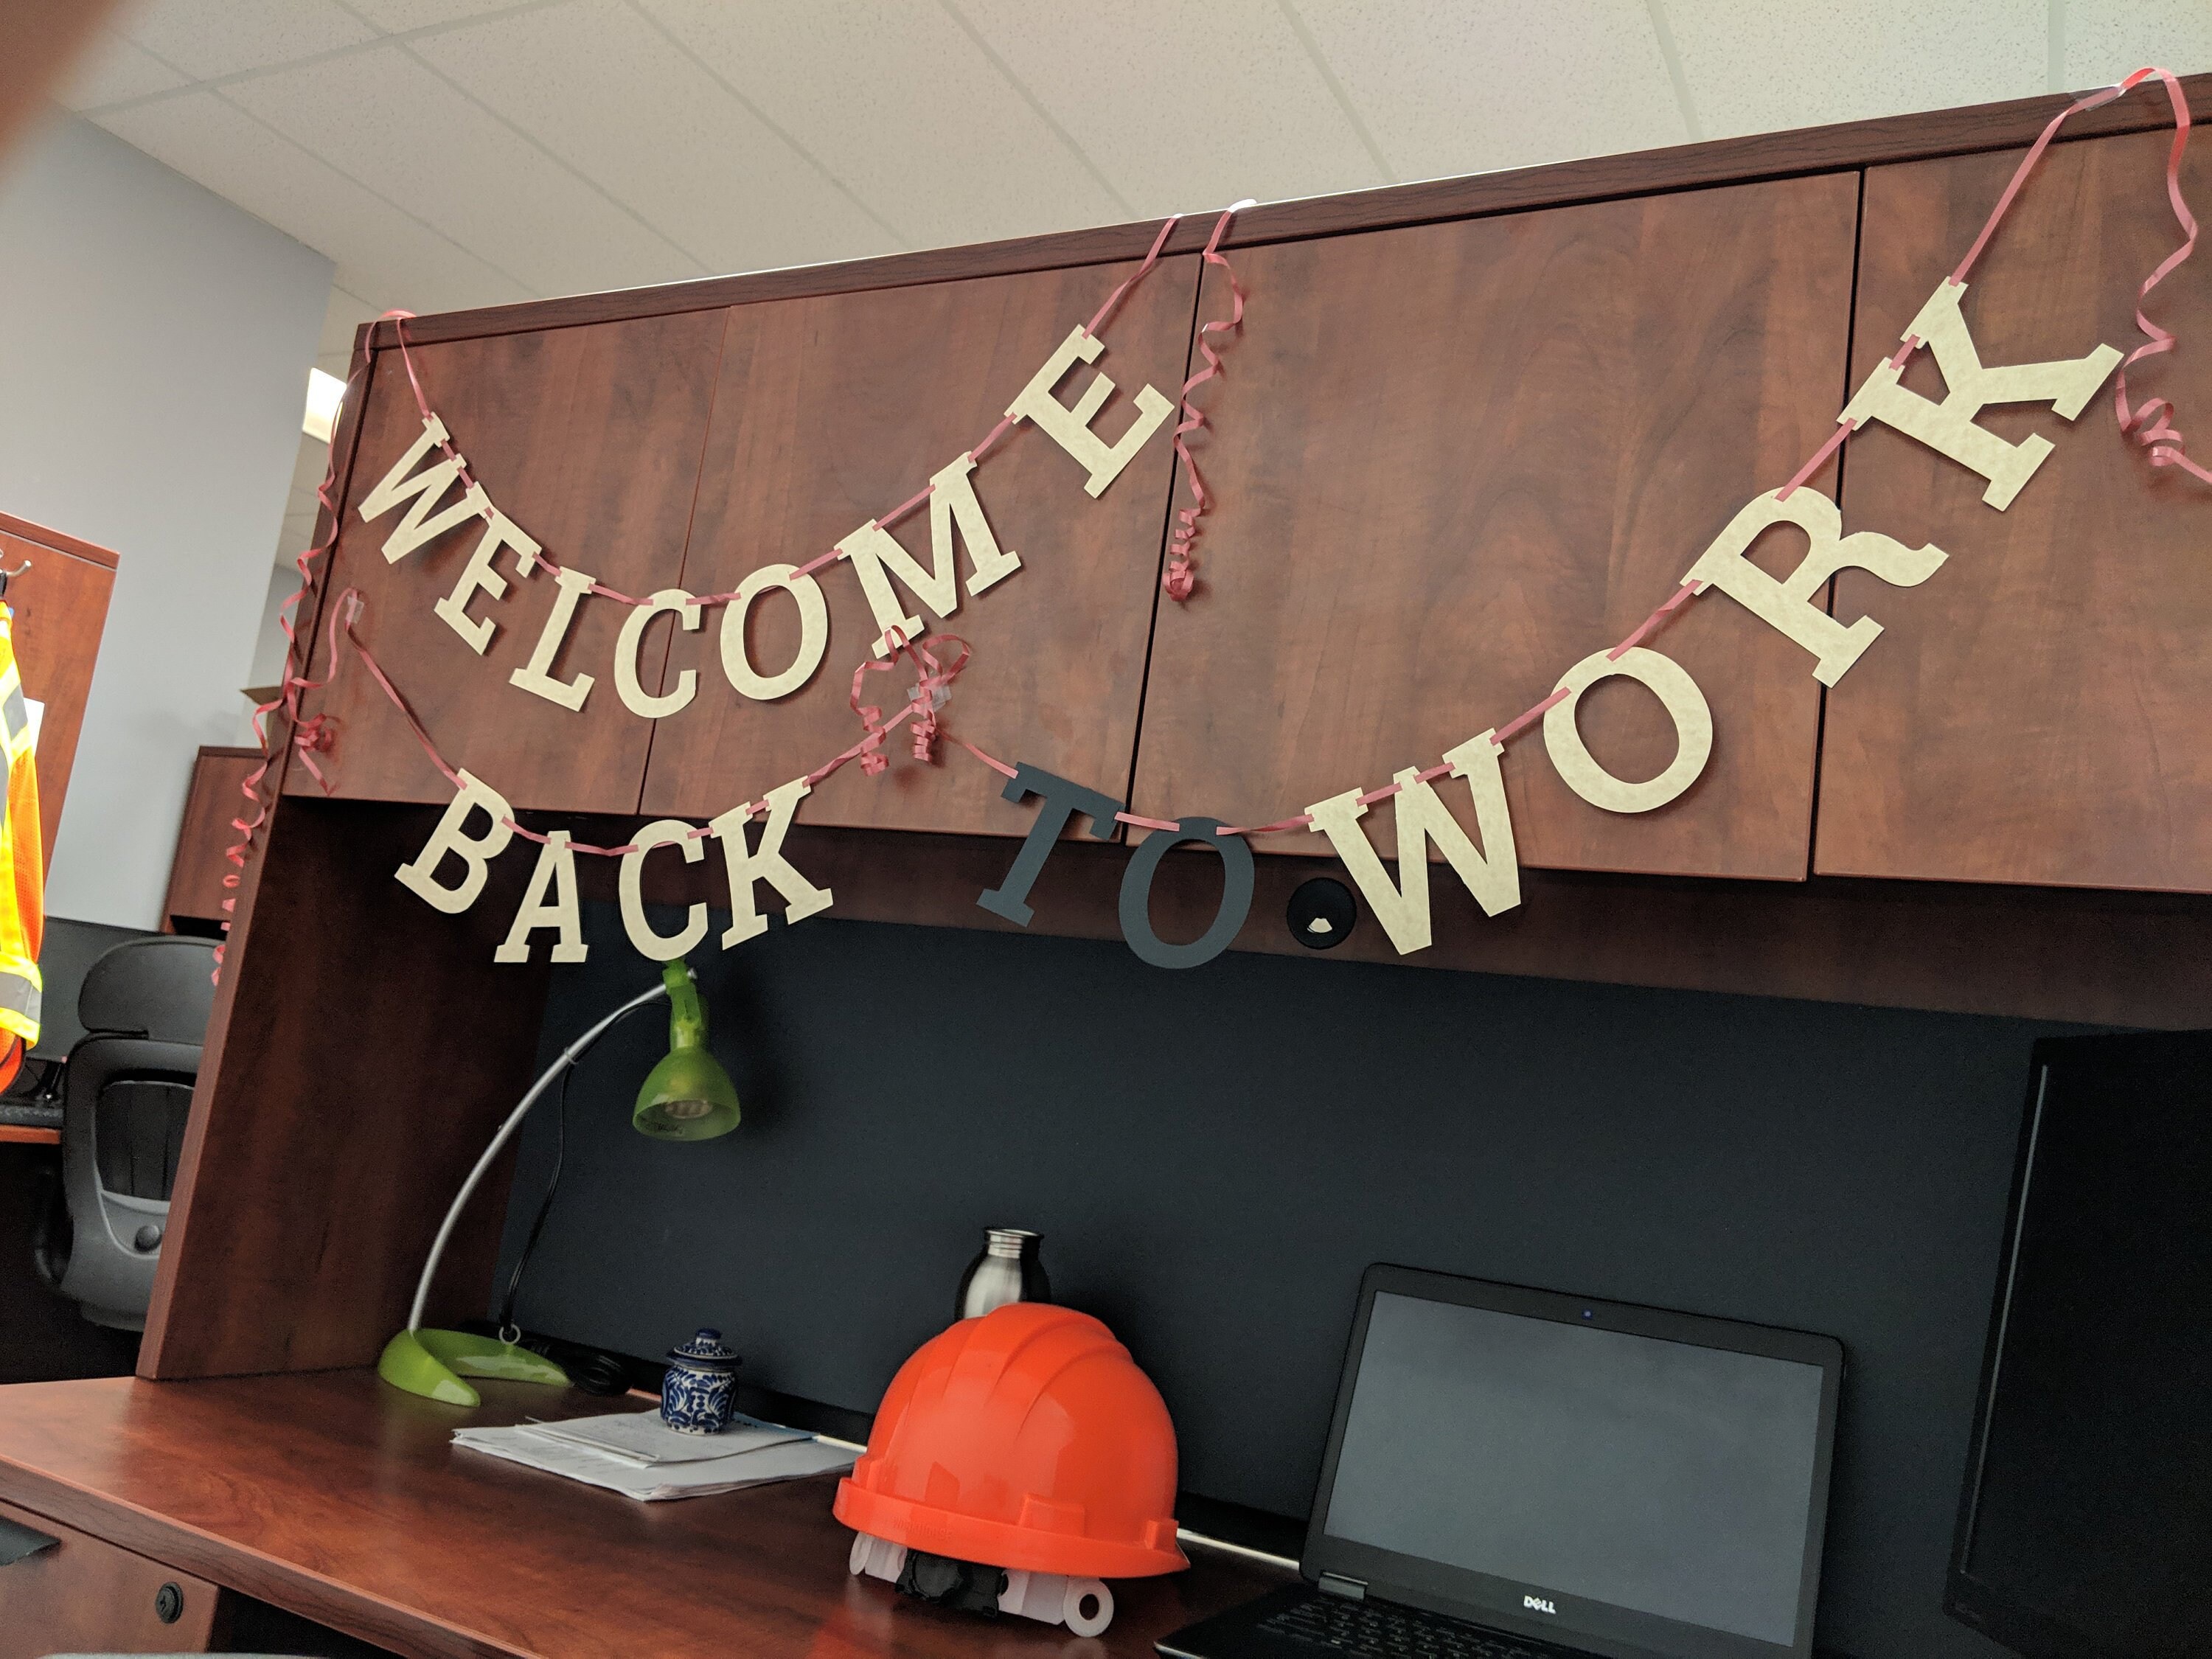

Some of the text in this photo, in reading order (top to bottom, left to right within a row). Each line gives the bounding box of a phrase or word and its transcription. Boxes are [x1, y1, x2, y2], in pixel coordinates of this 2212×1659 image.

[358, 324, 1174, 719] WELCOME
[394, 275, 2124, 970] BACK TO WORK
[1523, 1595, 1557, 1615] DELL
